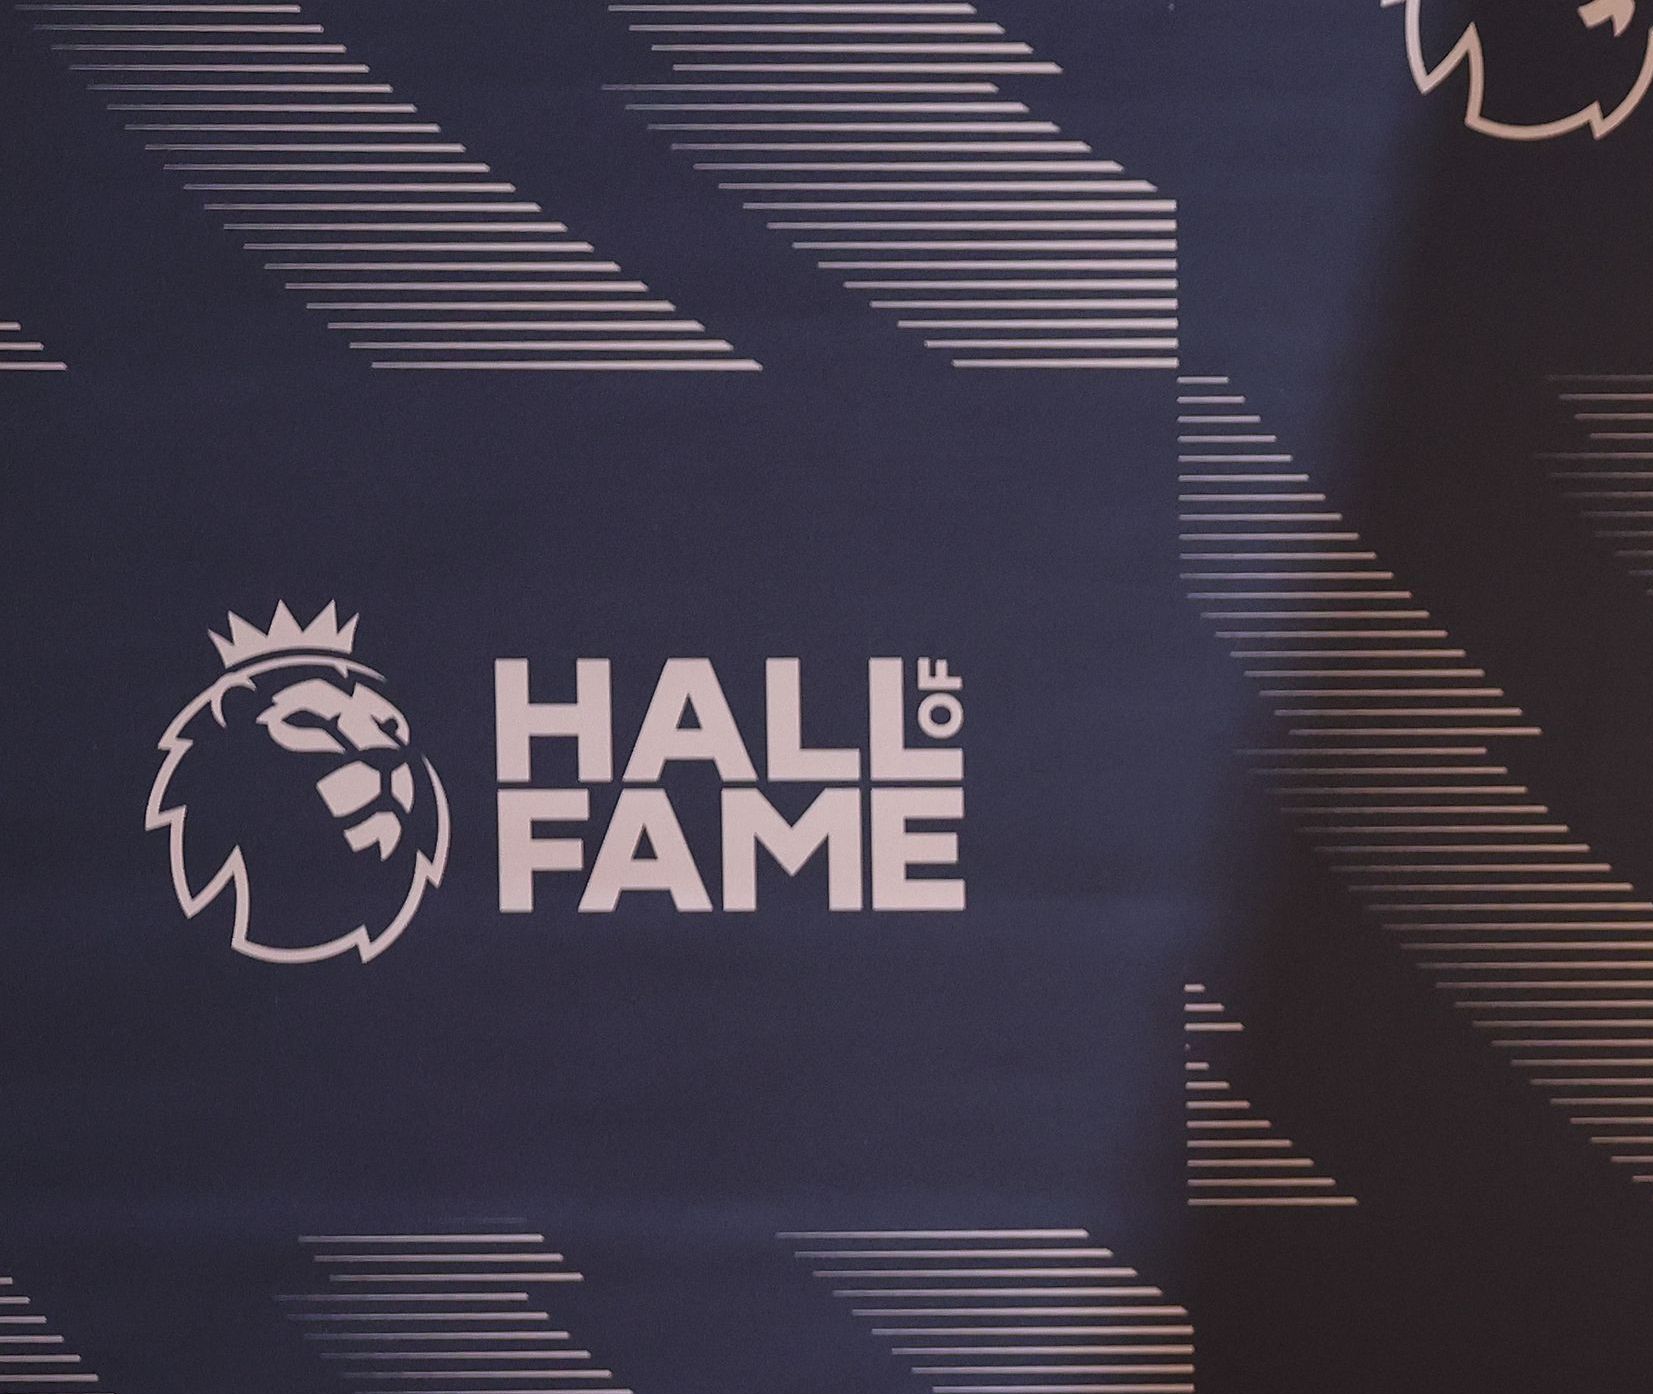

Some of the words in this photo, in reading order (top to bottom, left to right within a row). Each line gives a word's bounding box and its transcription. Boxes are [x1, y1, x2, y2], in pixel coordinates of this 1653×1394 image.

[494, 657, 964, 782] HALL
[917, 657, 963, 739] OF
[497, 787, 966, 912] FAME
